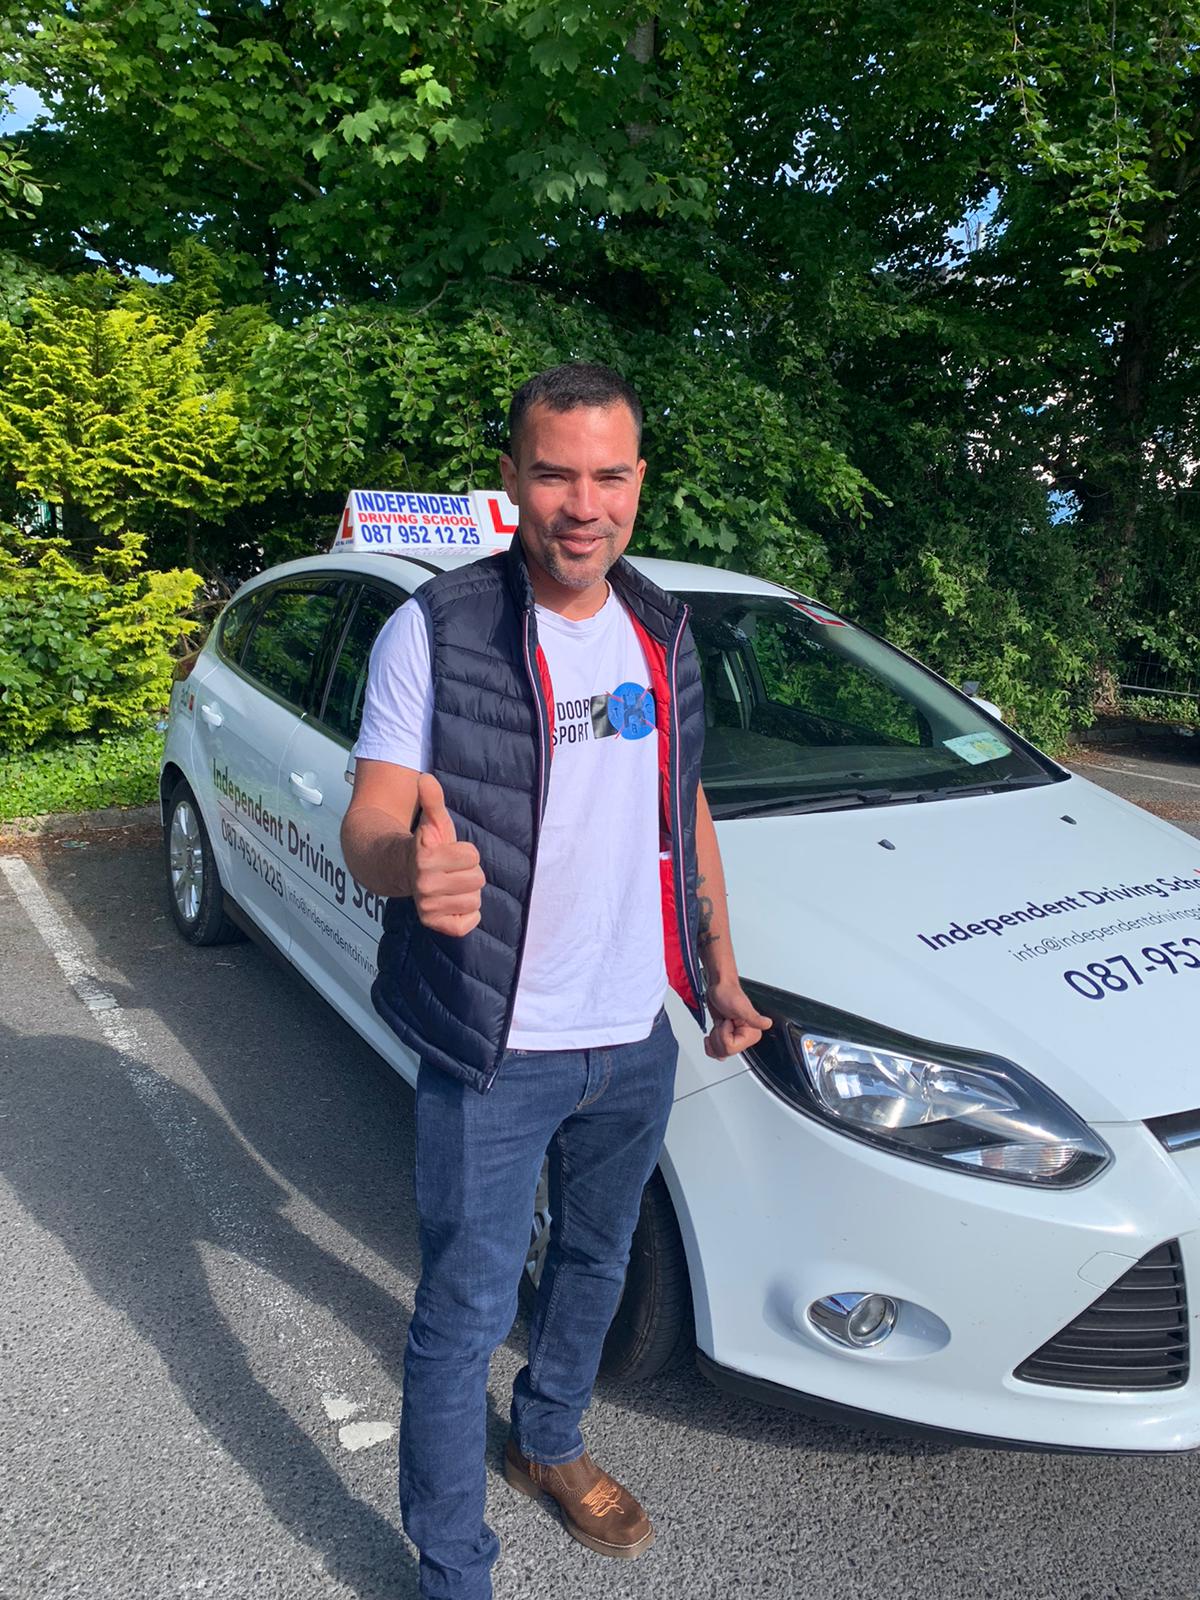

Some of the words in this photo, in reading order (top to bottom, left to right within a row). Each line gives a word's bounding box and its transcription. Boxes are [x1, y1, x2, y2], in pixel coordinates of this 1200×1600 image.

[354, 492, 472, 516] INDEPENDENT
[357, 512, 419, 525] DRIVING
[422, 514, 478, 527] SCHOOL
[361, 524, 392, 543] 087
[398, 525, 431, 544] 952
[435, 526, 456, 544] 12
[458, 527, 481, 545] 25
[556, 699, 590, 721] DOOR
[212, 757, 284, 846] Independent
[288, 819, 346, 906] Driving
[221, 817, 284, 899] 087-9521225
[916, 895, 1087, 951] Independent
[1078, 883, 1169, 907] Driving
[1062, 937, 1200, 1001] 087-952
